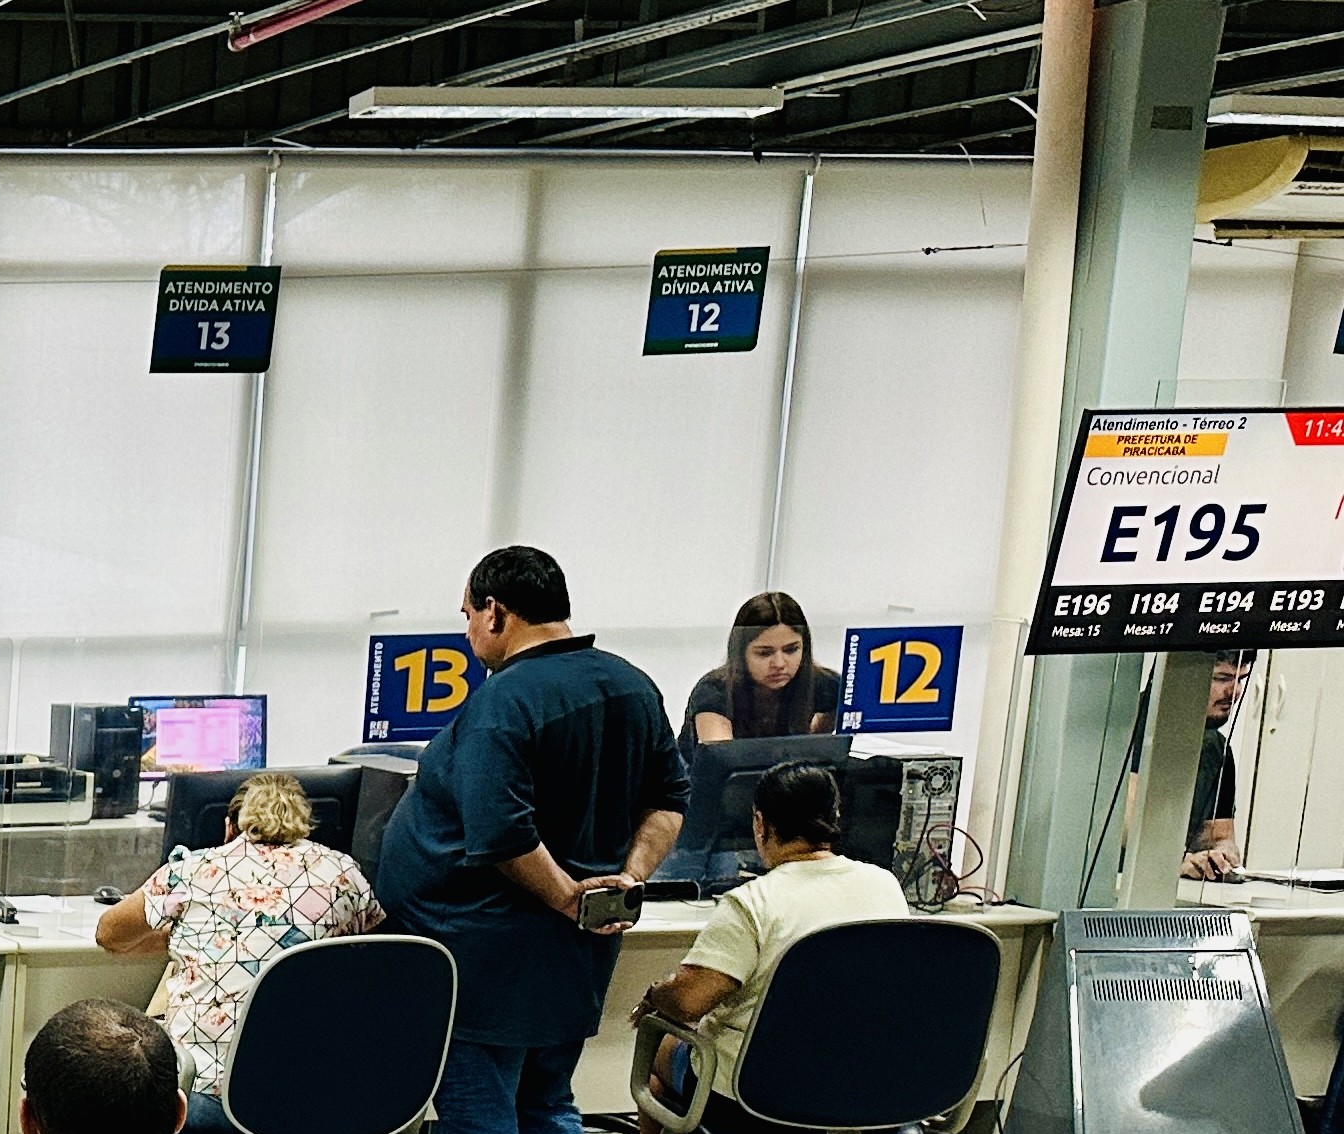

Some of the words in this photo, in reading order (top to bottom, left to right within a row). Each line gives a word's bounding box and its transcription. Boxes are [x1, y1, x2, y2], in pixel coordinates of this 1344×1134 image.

[658, 262, 762, 278] ATENDIMENTO
[165, 282, 272, 294] ATENDIMENTO
[662, 279, 709, 295] DÍVIDA
[712, 280, 754, 293] ATIVA
[169, 296, 219, 311] DÍVIDA
[222, 300, 266, 312] ATIVA
[688, 303, 721, 332] 12
[198, 321, 230, 350] 13
[1092, 418, 1178, 431] Atendimento
[1193, 417, 1234, 430] Térreo
[1238, 417, 1247, 430] 2
[1305, 419, 1344, 438] 11:4
[1117, 435, 1181, 445] PREFEITURA
[1183, 434, 1199, 444] DE
[1123, 446, 1186, 456] PIRACICABA
[1087, 464, 1220, 486] Convencional
[1100, 503, 1268, 562] E195
[1054, 594, 1112, 616] E196
[1130, 592, 1180, 615] I184
[1198, 591, 1255, 613] E194
[1269, 589, 1325, 611] E193
[1051, 625, 1084, 638] Mesa:
[1087, 625, 1101, 637] 15
[1123, 624, 1157, 636] Mesa:
[1160, 623, 1173, 635] 17
[1198, 622, 1231, 634] Mesa:
[1232, 621, 1241, 633] 2
[1269, 620, 1302, 632] Mesa:
[1302, 619, 1311, 631] 4
[370, 642, 384, 714] ATENDIMENTO
[394, 648, 469, 712] 13
[844, 634, 859, 706] ATENDIMENTO
[870, 641, 941, 704] 12
